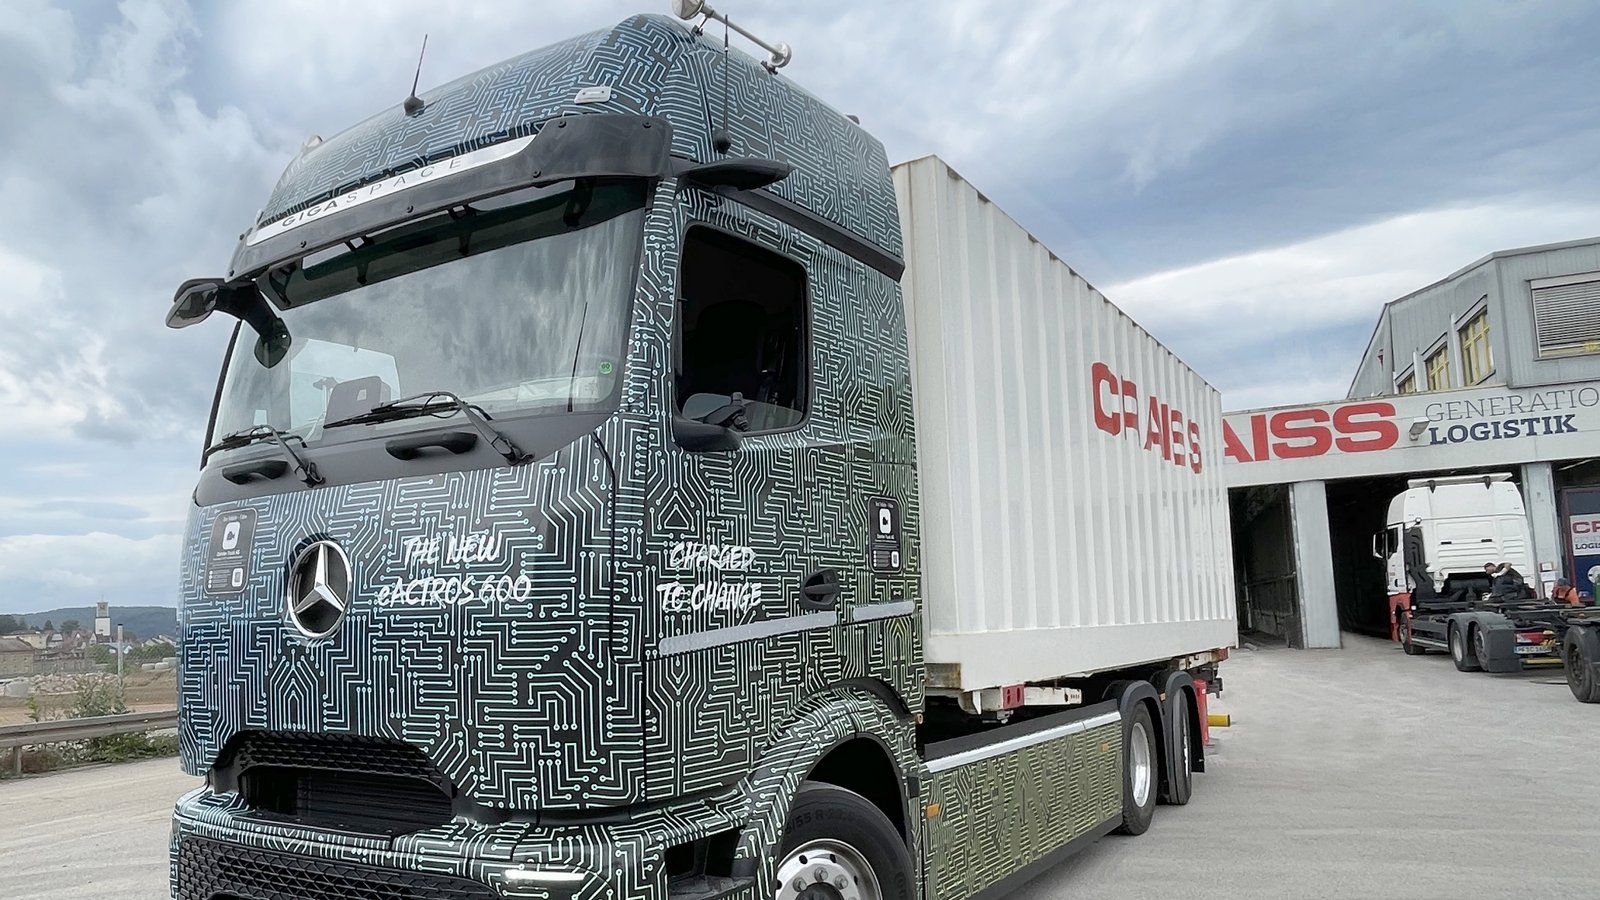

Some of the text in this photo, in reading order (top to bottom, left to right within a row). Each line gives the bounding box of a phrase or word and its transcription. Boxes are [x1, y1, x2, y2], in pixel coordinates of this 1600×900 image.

[1429, 414, 1578, 445] LOGISTIK
[404, 532, 502, 565] THE NEW
[670, 541, 756, 569] CHARGED
[377, 575, 532, 609] eACTROS 600
[656, 581, 761, 613] TO CHANGE
